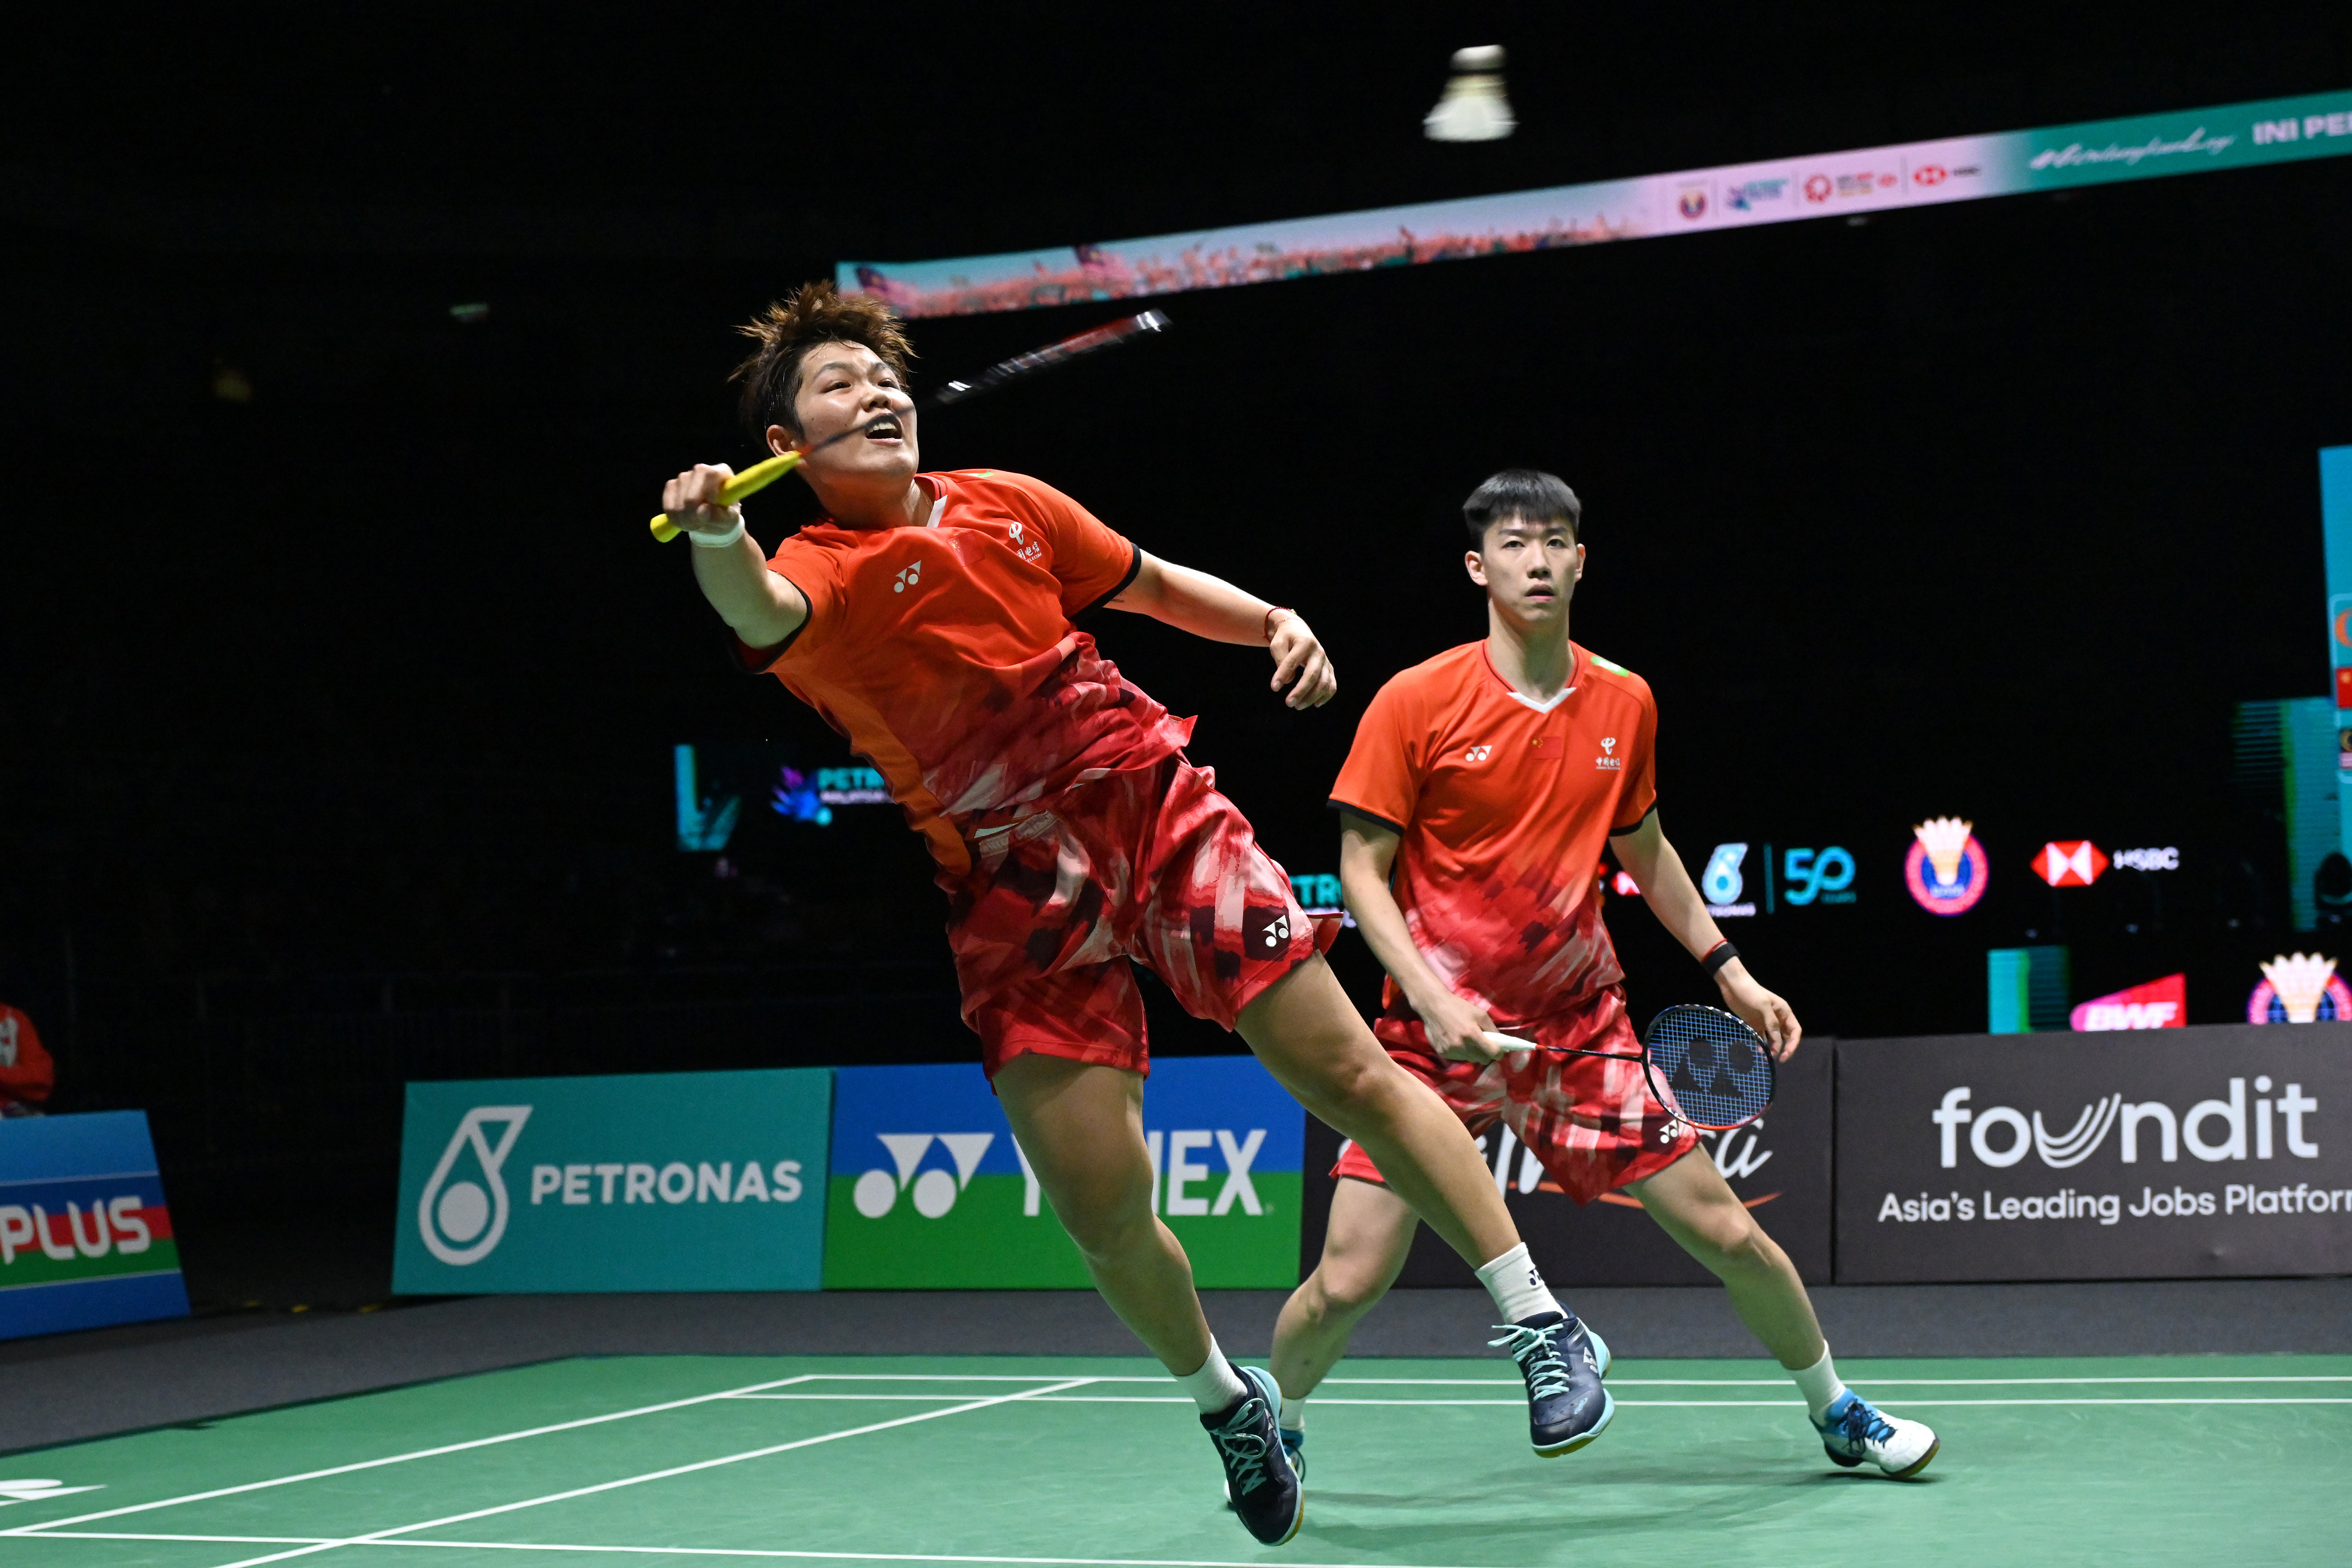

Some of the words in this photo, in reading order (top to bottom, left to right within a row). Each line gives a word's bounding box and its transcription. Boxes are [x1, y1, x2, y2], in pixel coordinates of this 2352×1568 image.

[2253, 118, 2298, 145] INI
[1784, 846, 1855, 905] 50
[2085, 1002, 2177, 1031] BWF
[1933, 1075, 2318, 1169] foundit
[531, 1160, 802, 1205] PETRONAS
[1011, 1129, 1267, 1216] YEX
[0, 1195, 152, 1265] PLUS
[1984, 1189, 2120, 1225] Leading
[2129, 1186, 2216, 1217] Jobs
